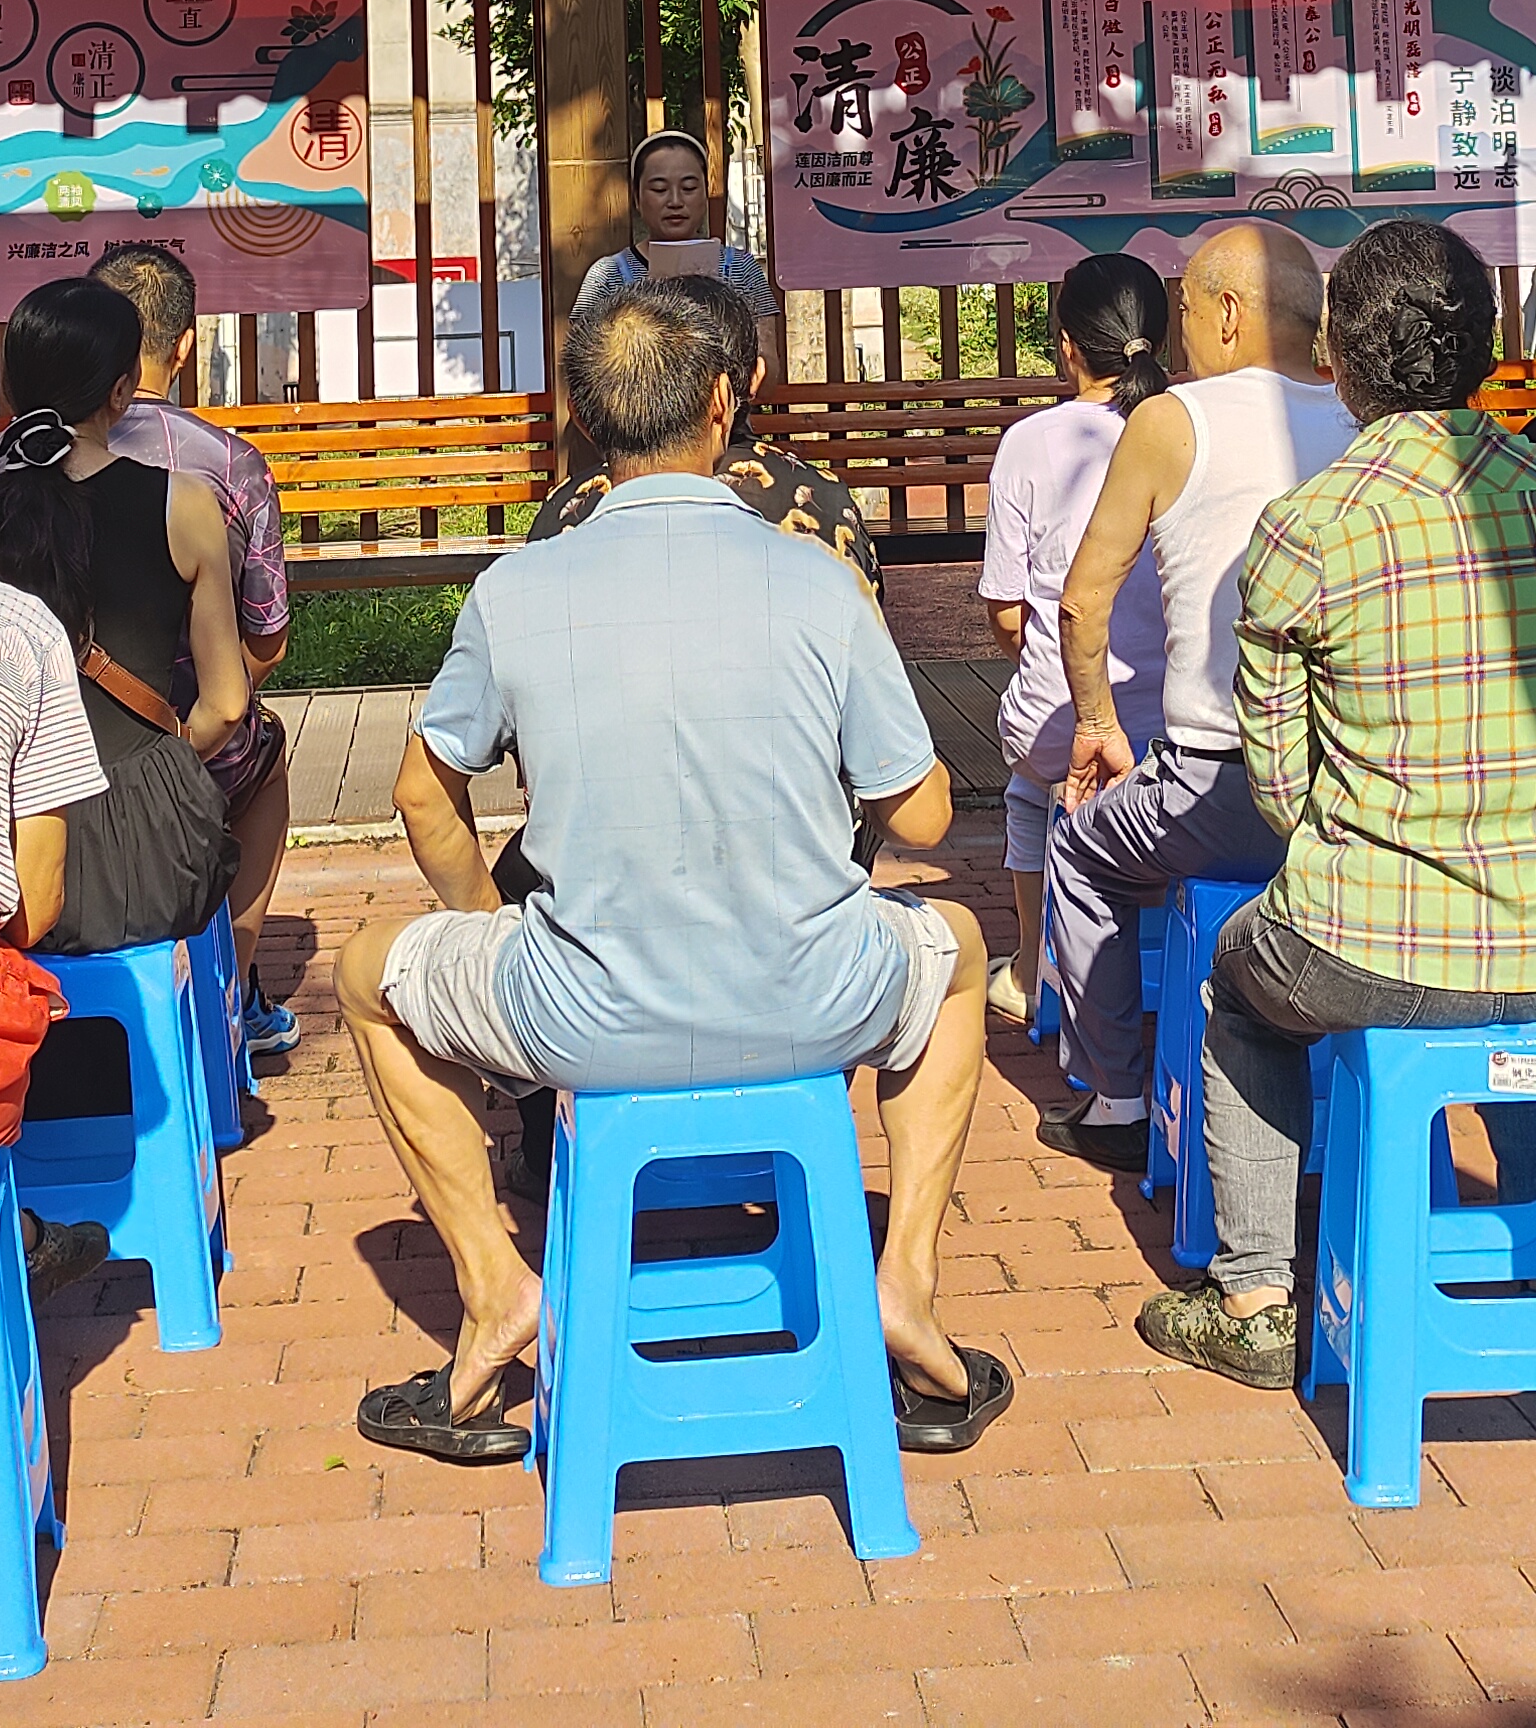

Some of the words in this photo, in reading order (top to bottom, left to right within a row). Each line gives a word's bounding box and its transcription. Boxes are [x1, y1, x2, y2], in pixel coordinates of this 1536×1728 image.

[88, 40, 116, 99] 清正
[900, 40, 924, 86] 公正
[300, 108, 353, 162] 清
[1450, 67, 1481, 191] 宁静致远
[1489, 65, 1519, 189] 淡泊明志
[794, 171, 872, 189] 人因廉而正
[795, 150, 873, 169] 莲因洁而尊
[7, 240, 90, 260] 兴廉洁之风
